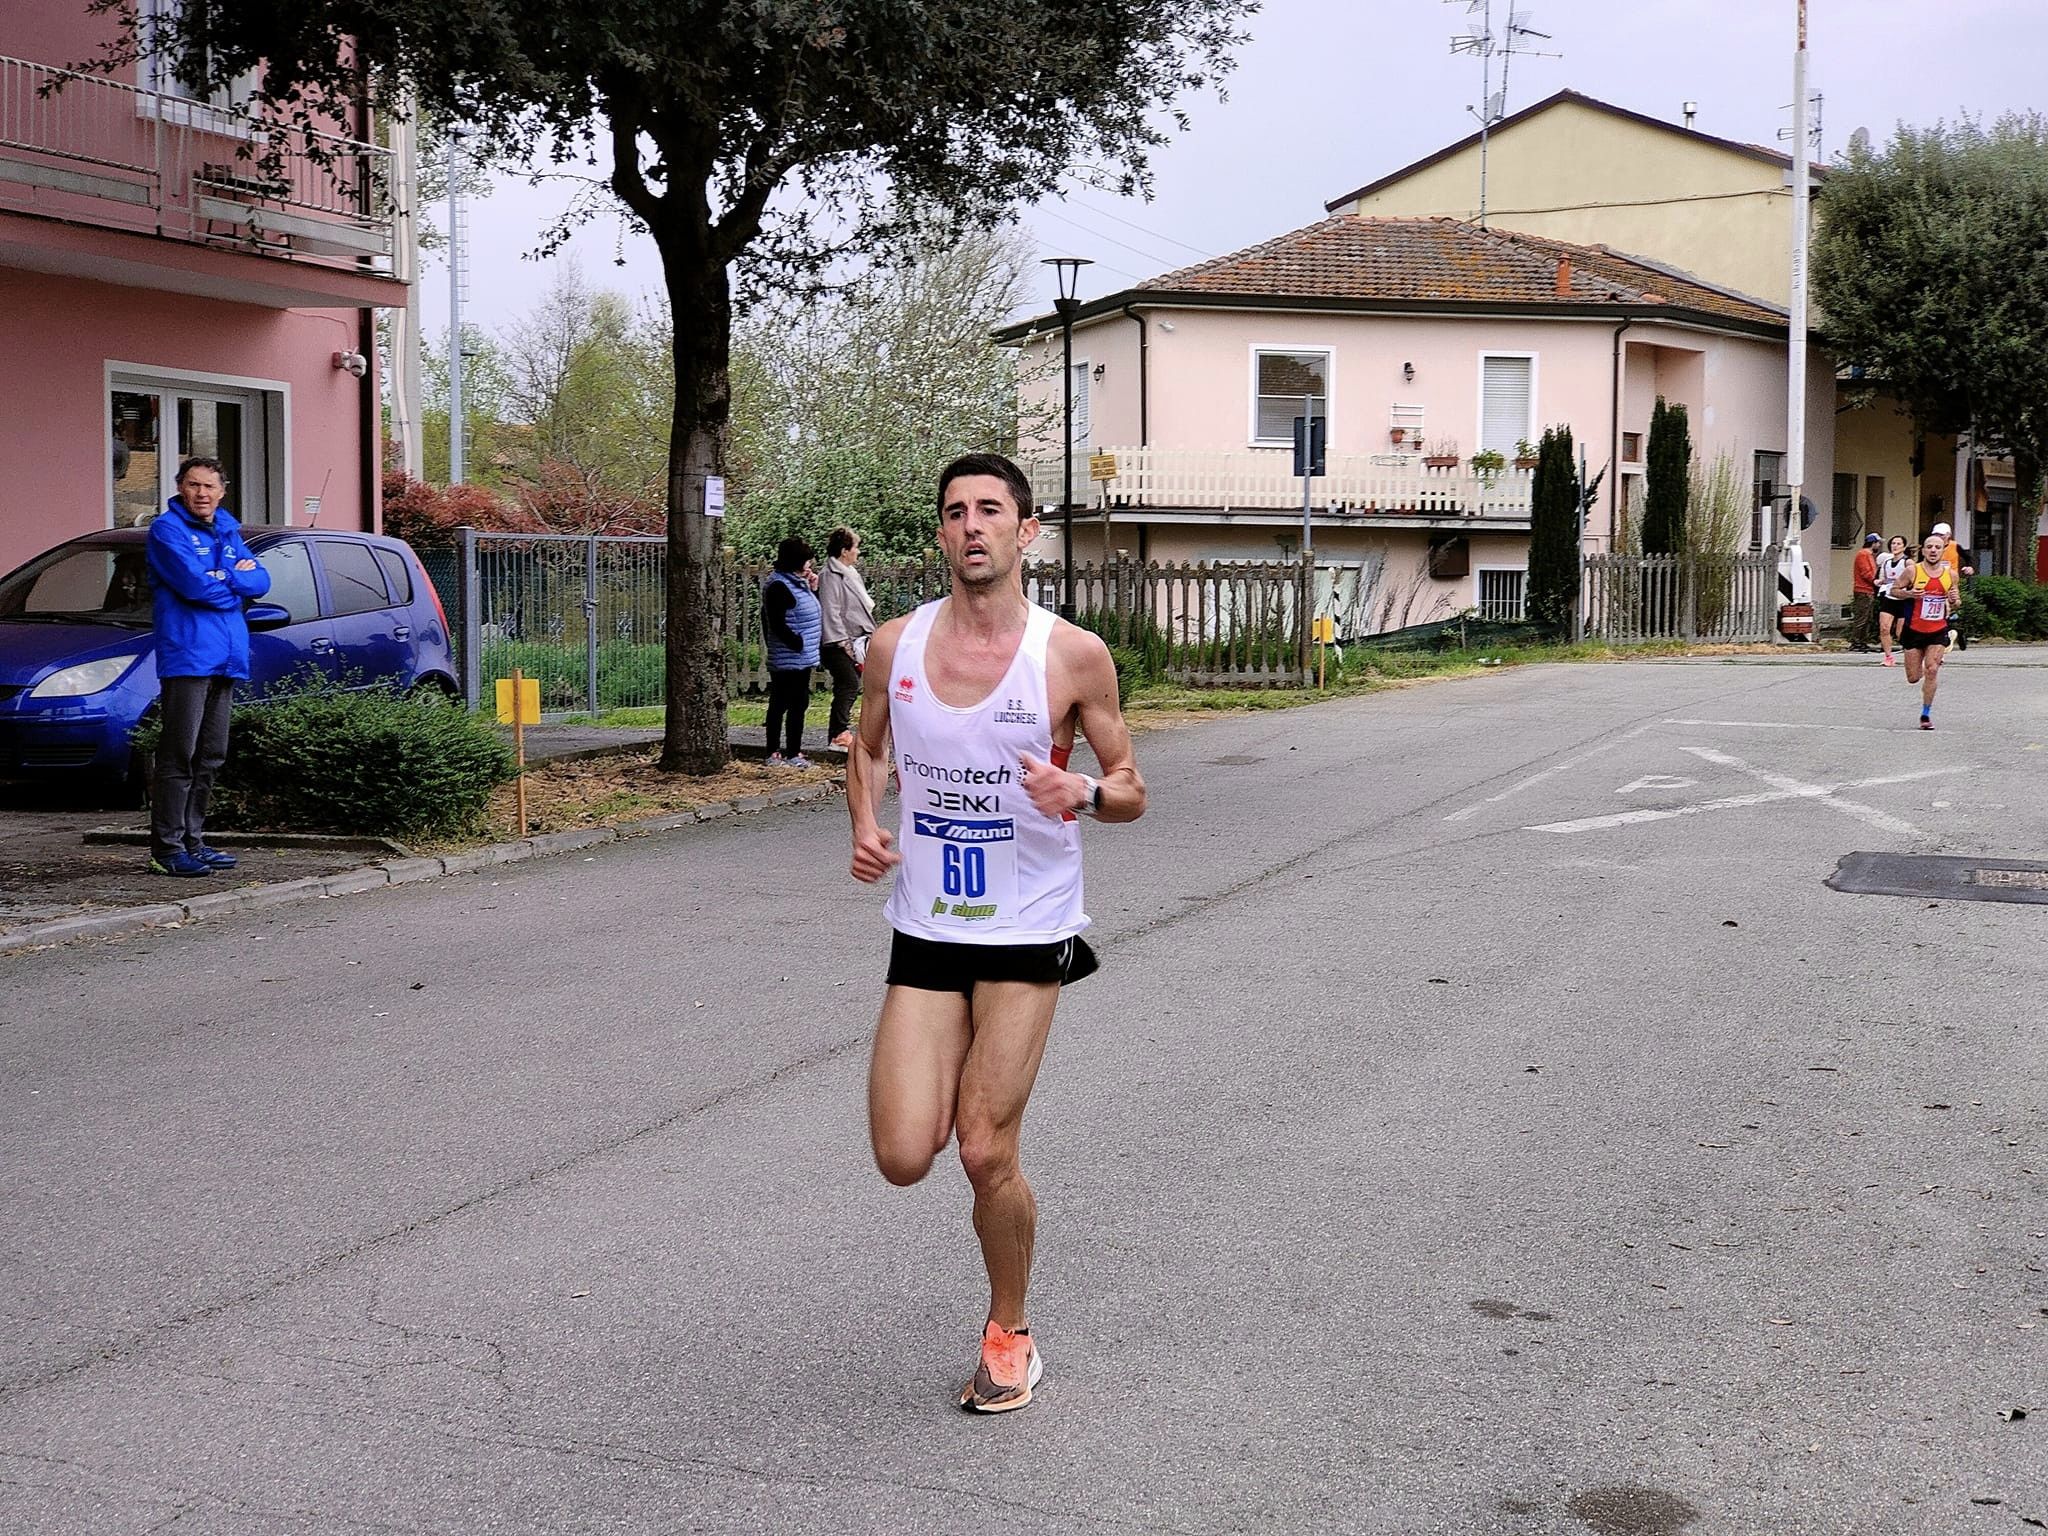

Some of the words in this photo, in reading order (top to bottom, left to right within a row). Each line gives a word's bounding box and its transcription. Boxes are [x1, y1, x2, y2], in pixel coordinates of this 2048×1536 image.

[903, 752, 1012, 785] Promotech
[927, 788, 1000, 813] DENKI
[943, 843, 986, 898] 60
